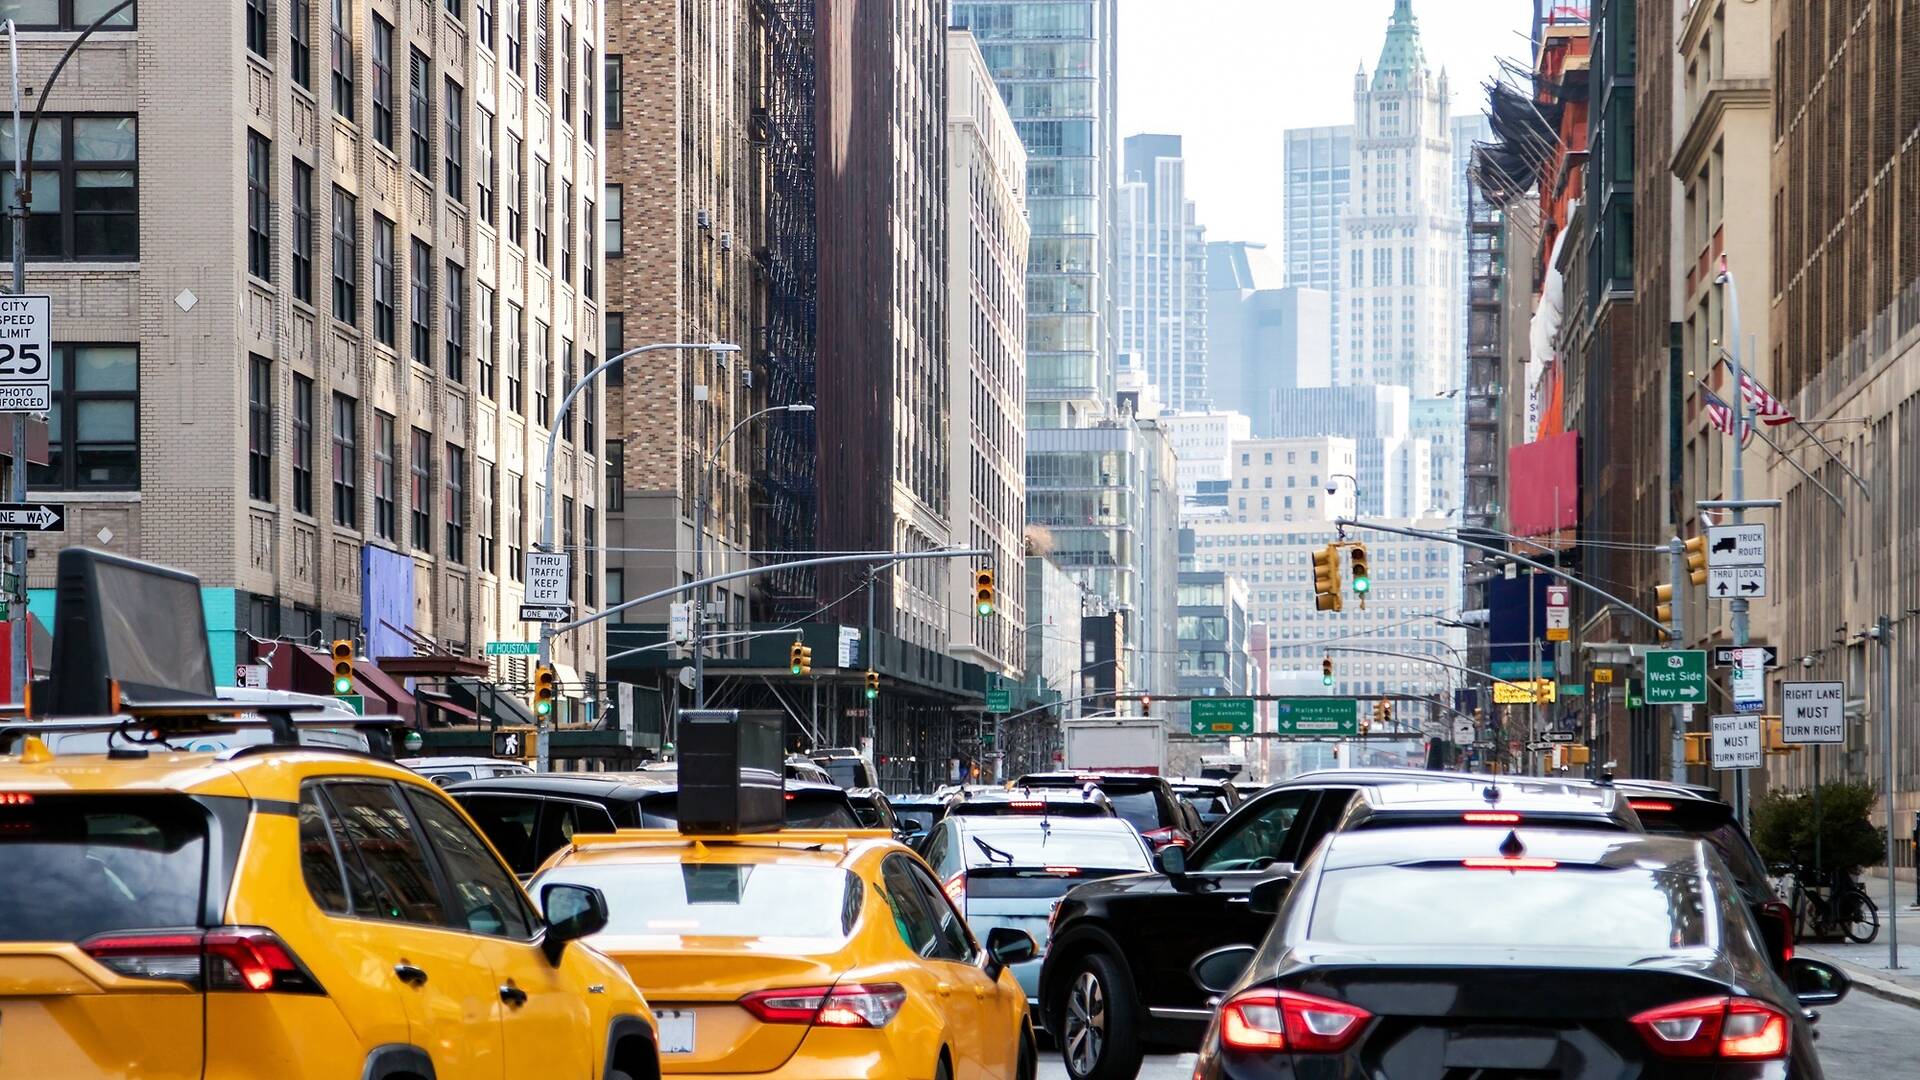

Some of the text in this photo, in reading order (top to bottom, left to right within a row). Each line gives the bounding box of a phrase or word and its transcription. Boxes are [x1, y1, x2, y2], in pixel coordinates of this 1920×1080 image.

[1, 301, 29, 311] CITY
[0, 329, 31, 339] LIMIT
[0, 344, 42, 375] 25
[0, 388, 34, 397] PHOTO
[26, 512, 52, 523] WAY
[1738, 534, 1763, 542] TRUCK
[1738, 547, 1763, 556] ROUTE
[535, 556, 560, 566] THRU
[530, 568, 564, 577] TRAFFIC
[1713, 570, 1733, 578] THRU
[1739, 569, 1763, 578] LOCAL
[534, 579, 558, 588] KEEP
[534, 590, 558, 599] LEFT
[526, 610, 563, 619] ONE WAY
[496, 643, 530, 653] HOUSTON
[1669, 658, 1682, 666] 9A
[1650, 671, 1702, 681] West Side
[1652, 687, 1676, 698] Hwy
[1785, 690, 1841, 700] RIGHT LANE
[1797, 706, 1829, 719] MUST
[1715, 721, 1758, 731] RIGHT LANE
[1785, 725, 1841, 736] TURN RIGHT
[1724, 736, 1749, 747] MUST
[1715, 752, 1759, 762] TURN RIGHT
